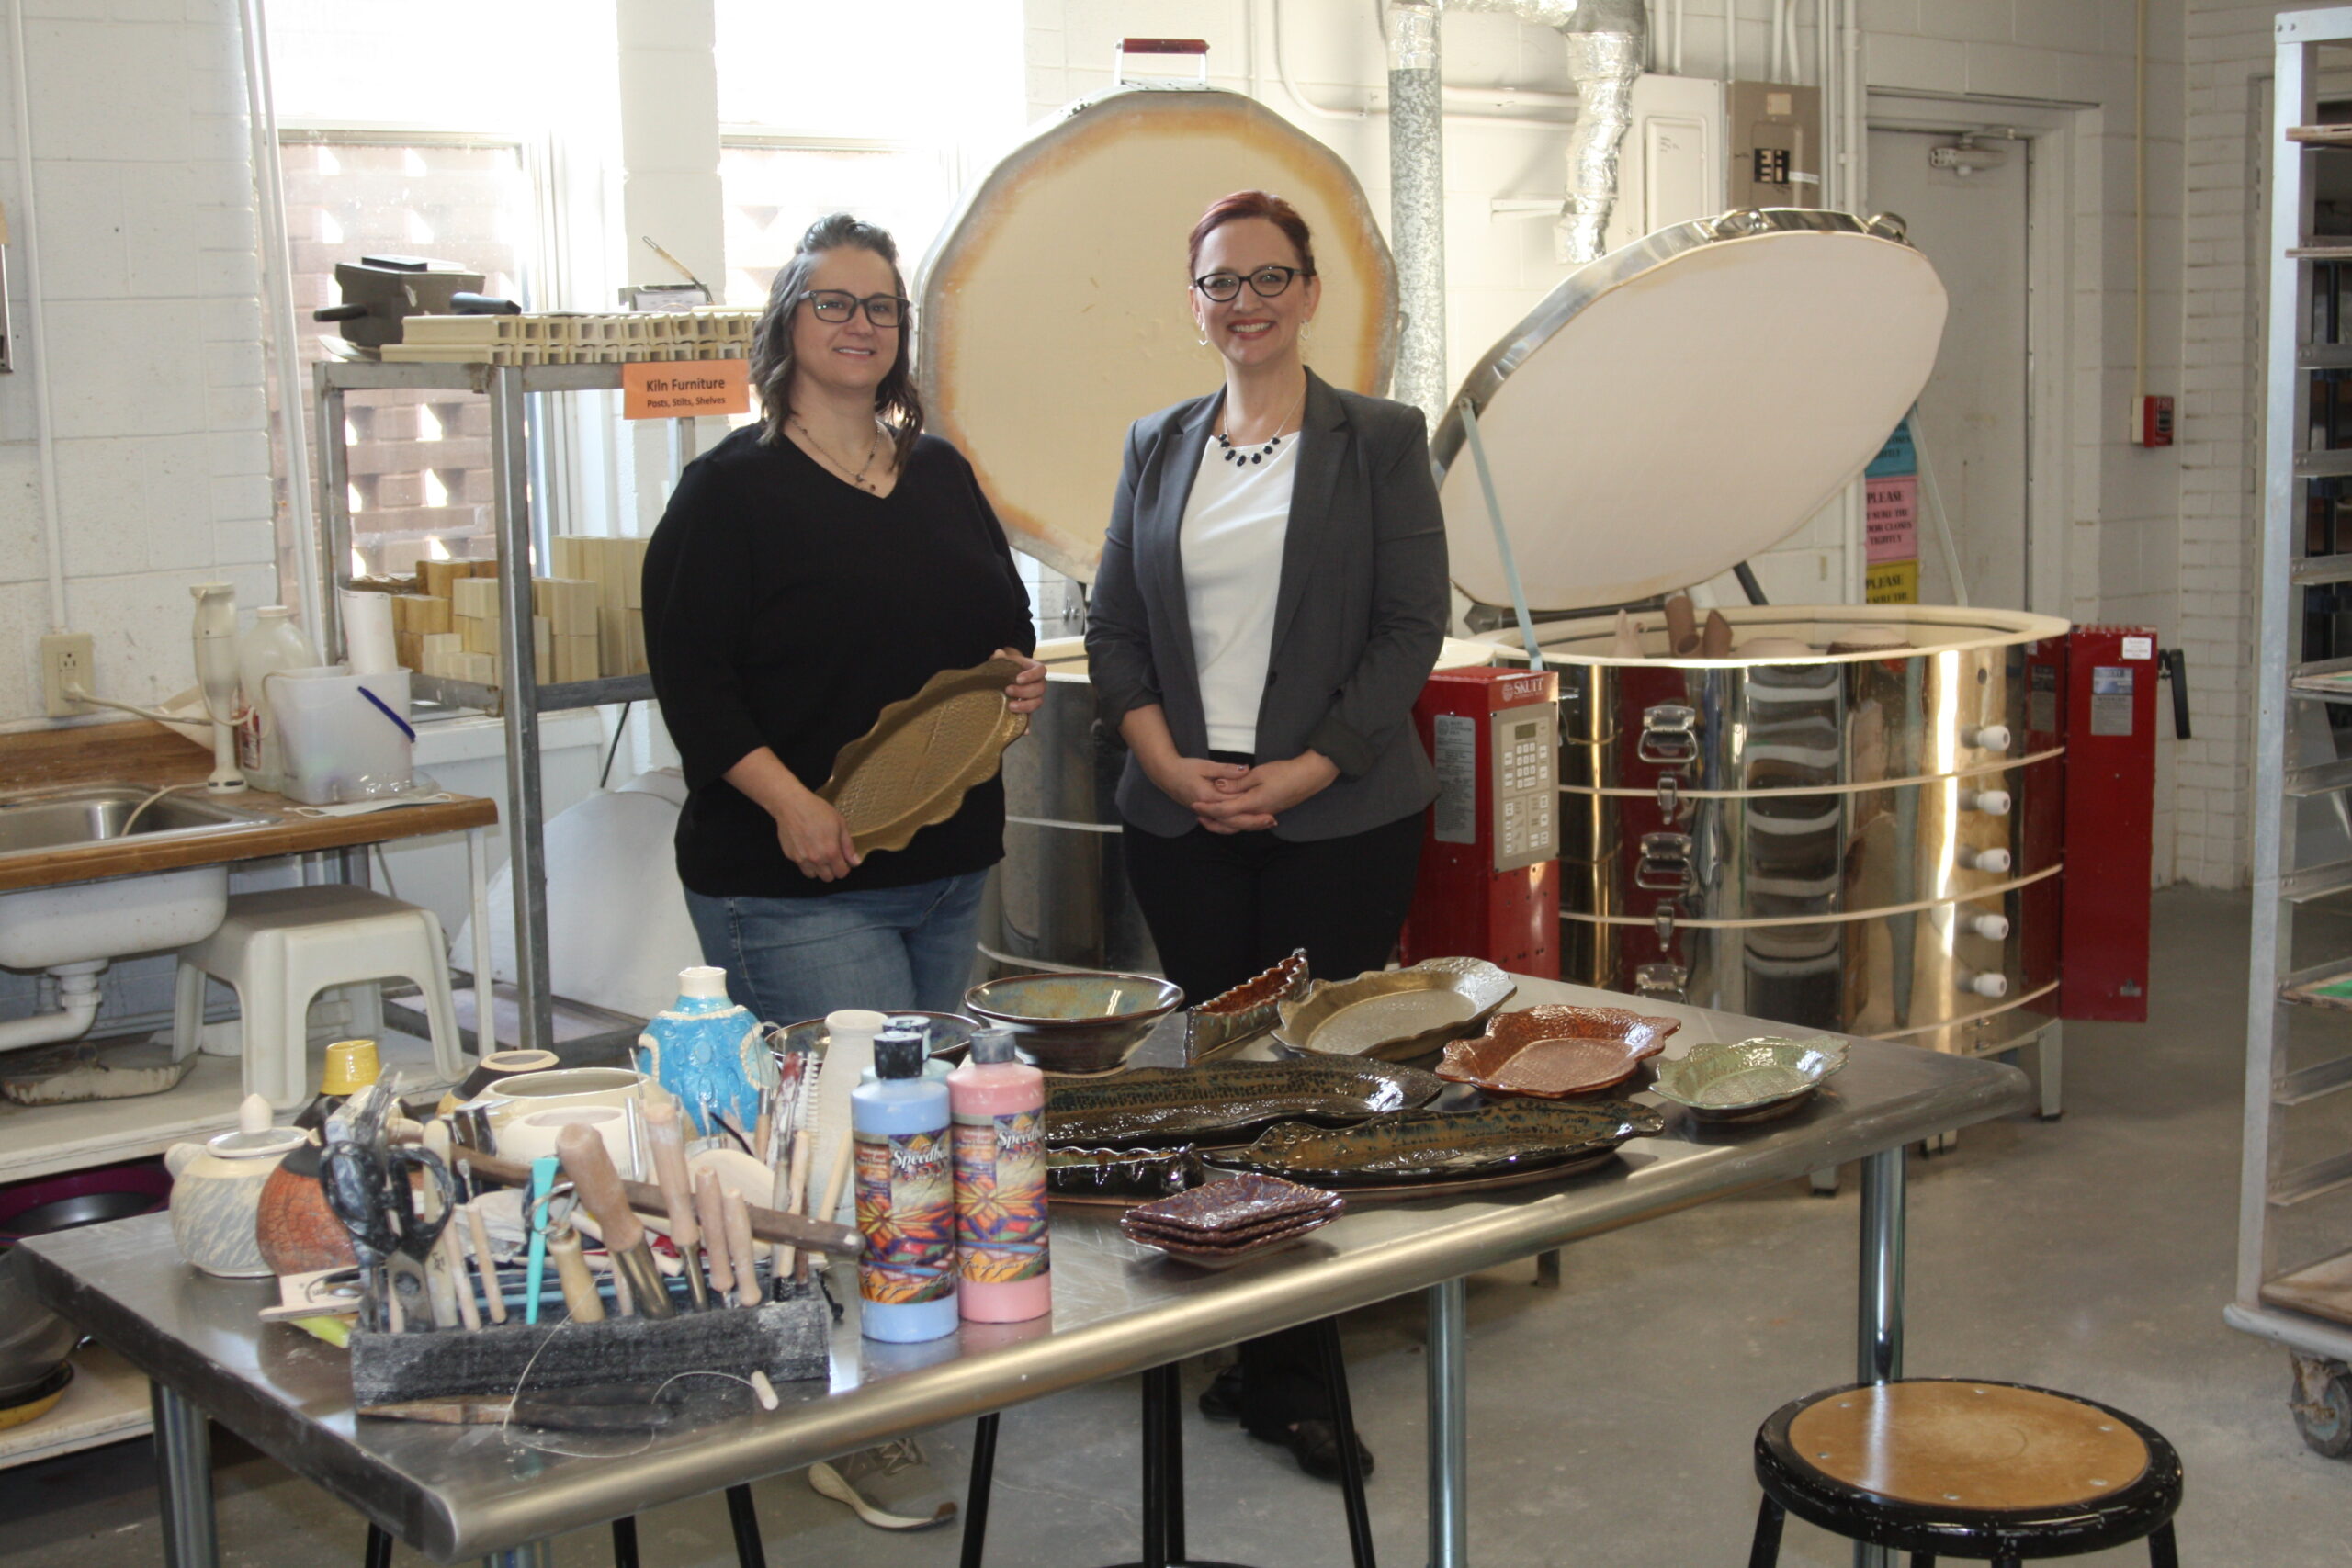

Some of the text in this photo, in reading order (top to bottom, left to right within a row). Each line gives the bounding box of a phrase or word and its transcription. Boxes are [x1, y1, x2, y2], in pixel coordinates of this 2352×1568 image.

[646, 378, 725, 392] Kiln Furniture
[647, 396, 726, 408] Posts, Stilts, Shelves
[1866, 491, 1904, 504] PLEASE
[1870, 534, 1903, 545] TIGHTLY
[1865, 573, 1904, 589] PLEASE
[1513, 678, 1544, 694] SKUTT
